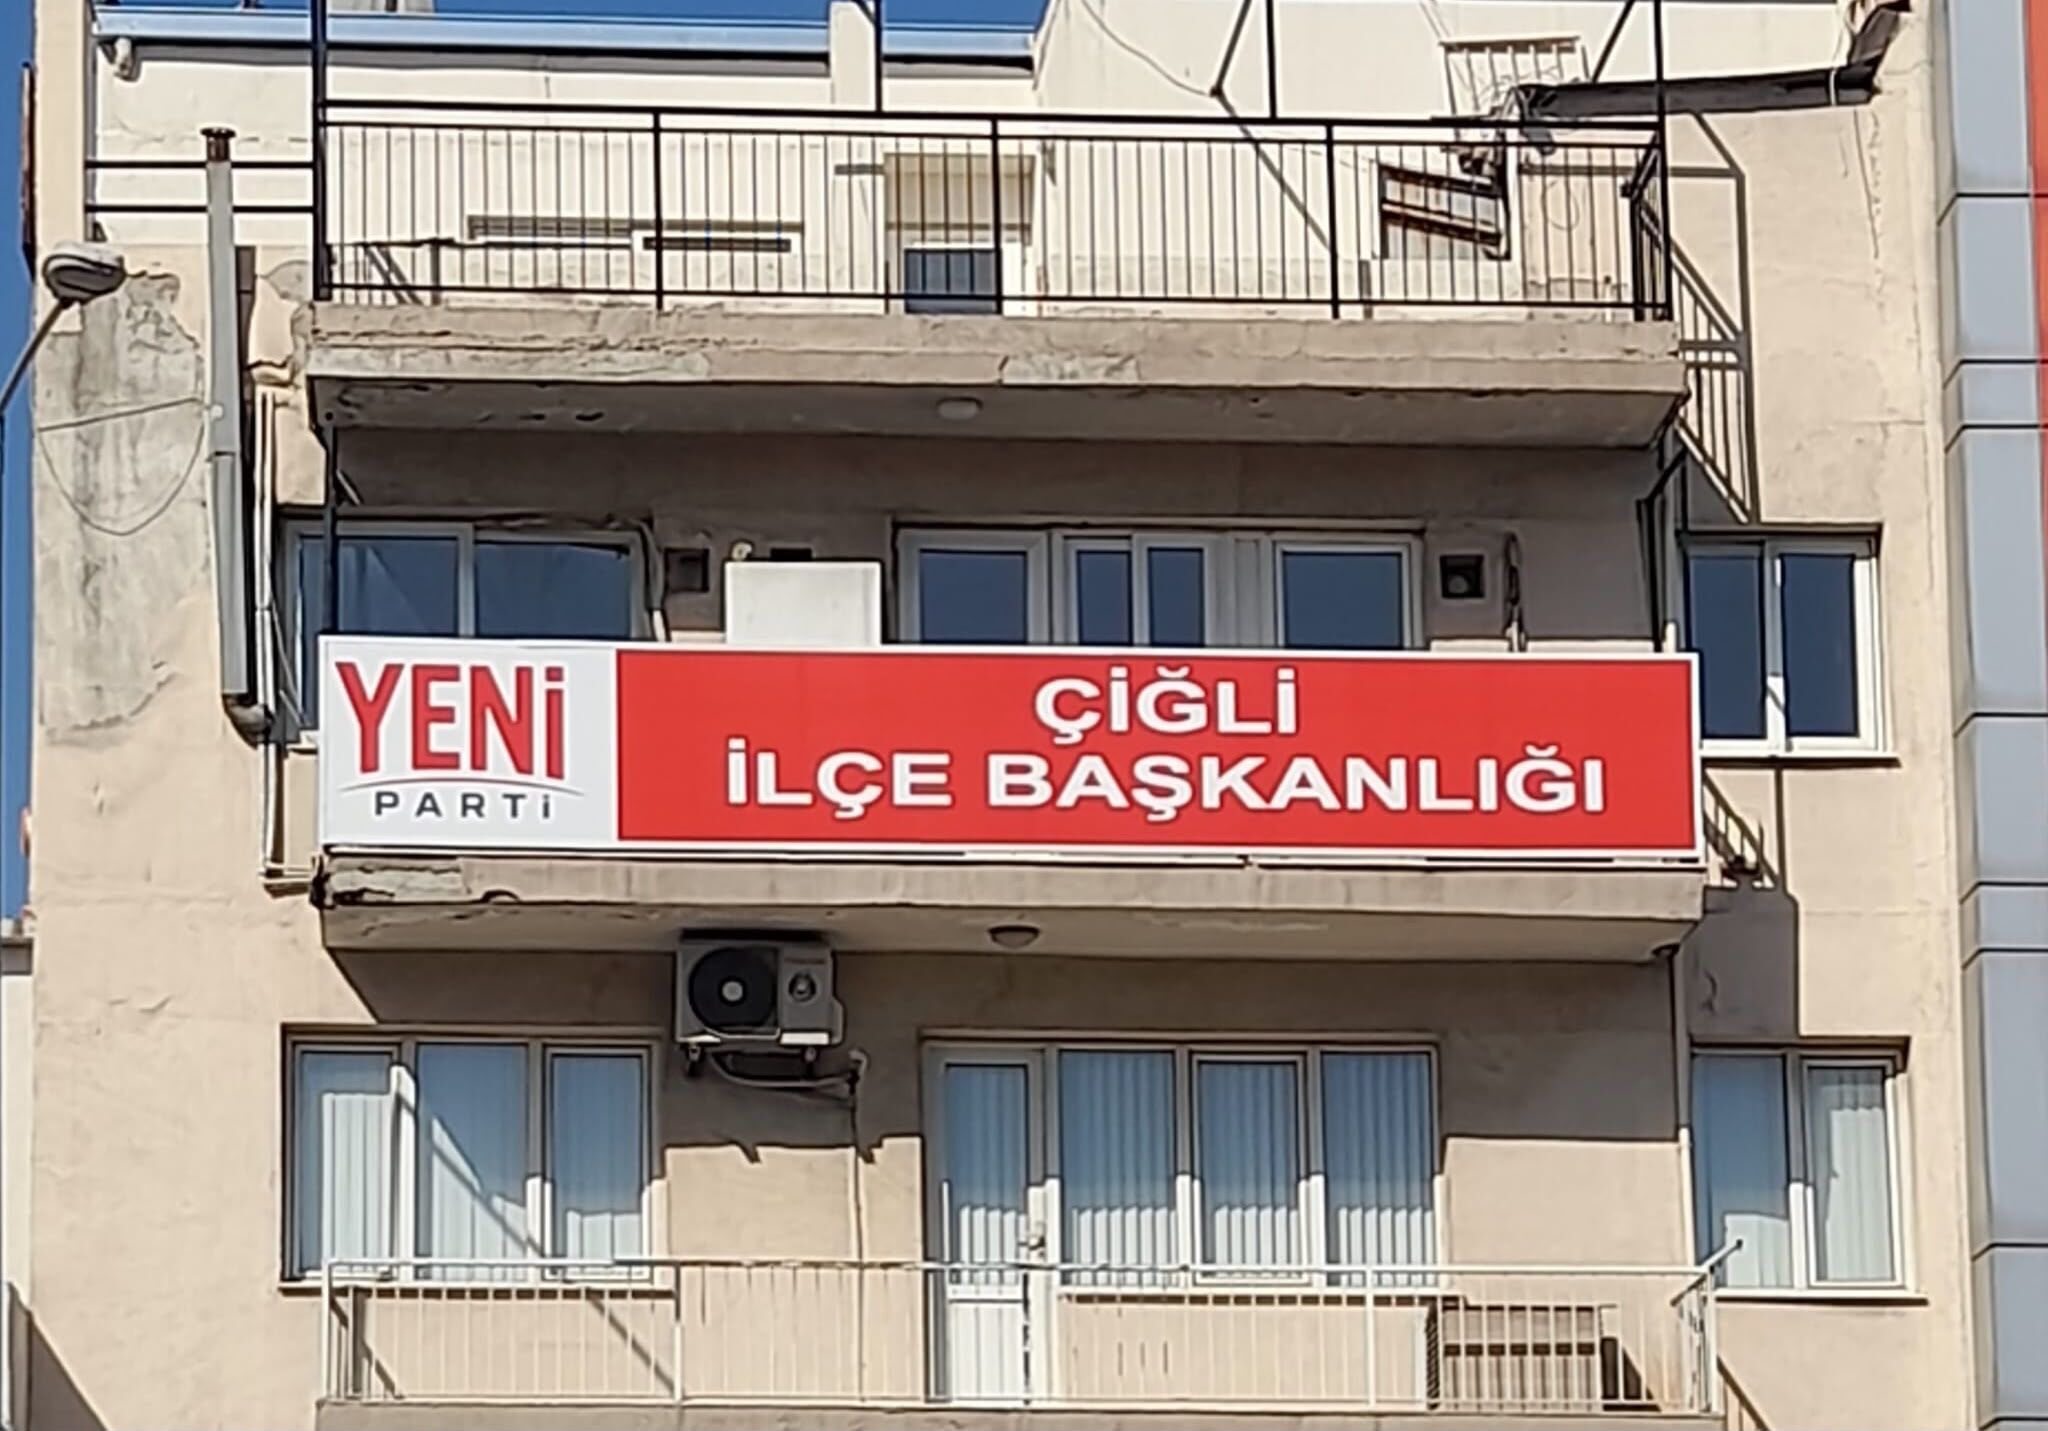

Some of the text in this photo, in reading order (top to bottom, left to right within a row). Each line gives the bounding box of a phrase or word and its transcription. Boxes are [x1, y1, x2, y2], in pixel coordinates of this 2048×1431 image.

[1035, 666, 1296, 745] ÇİĞLİ
[727, 737, 1604, 822] İLÇE BAŞKANLIĞI
